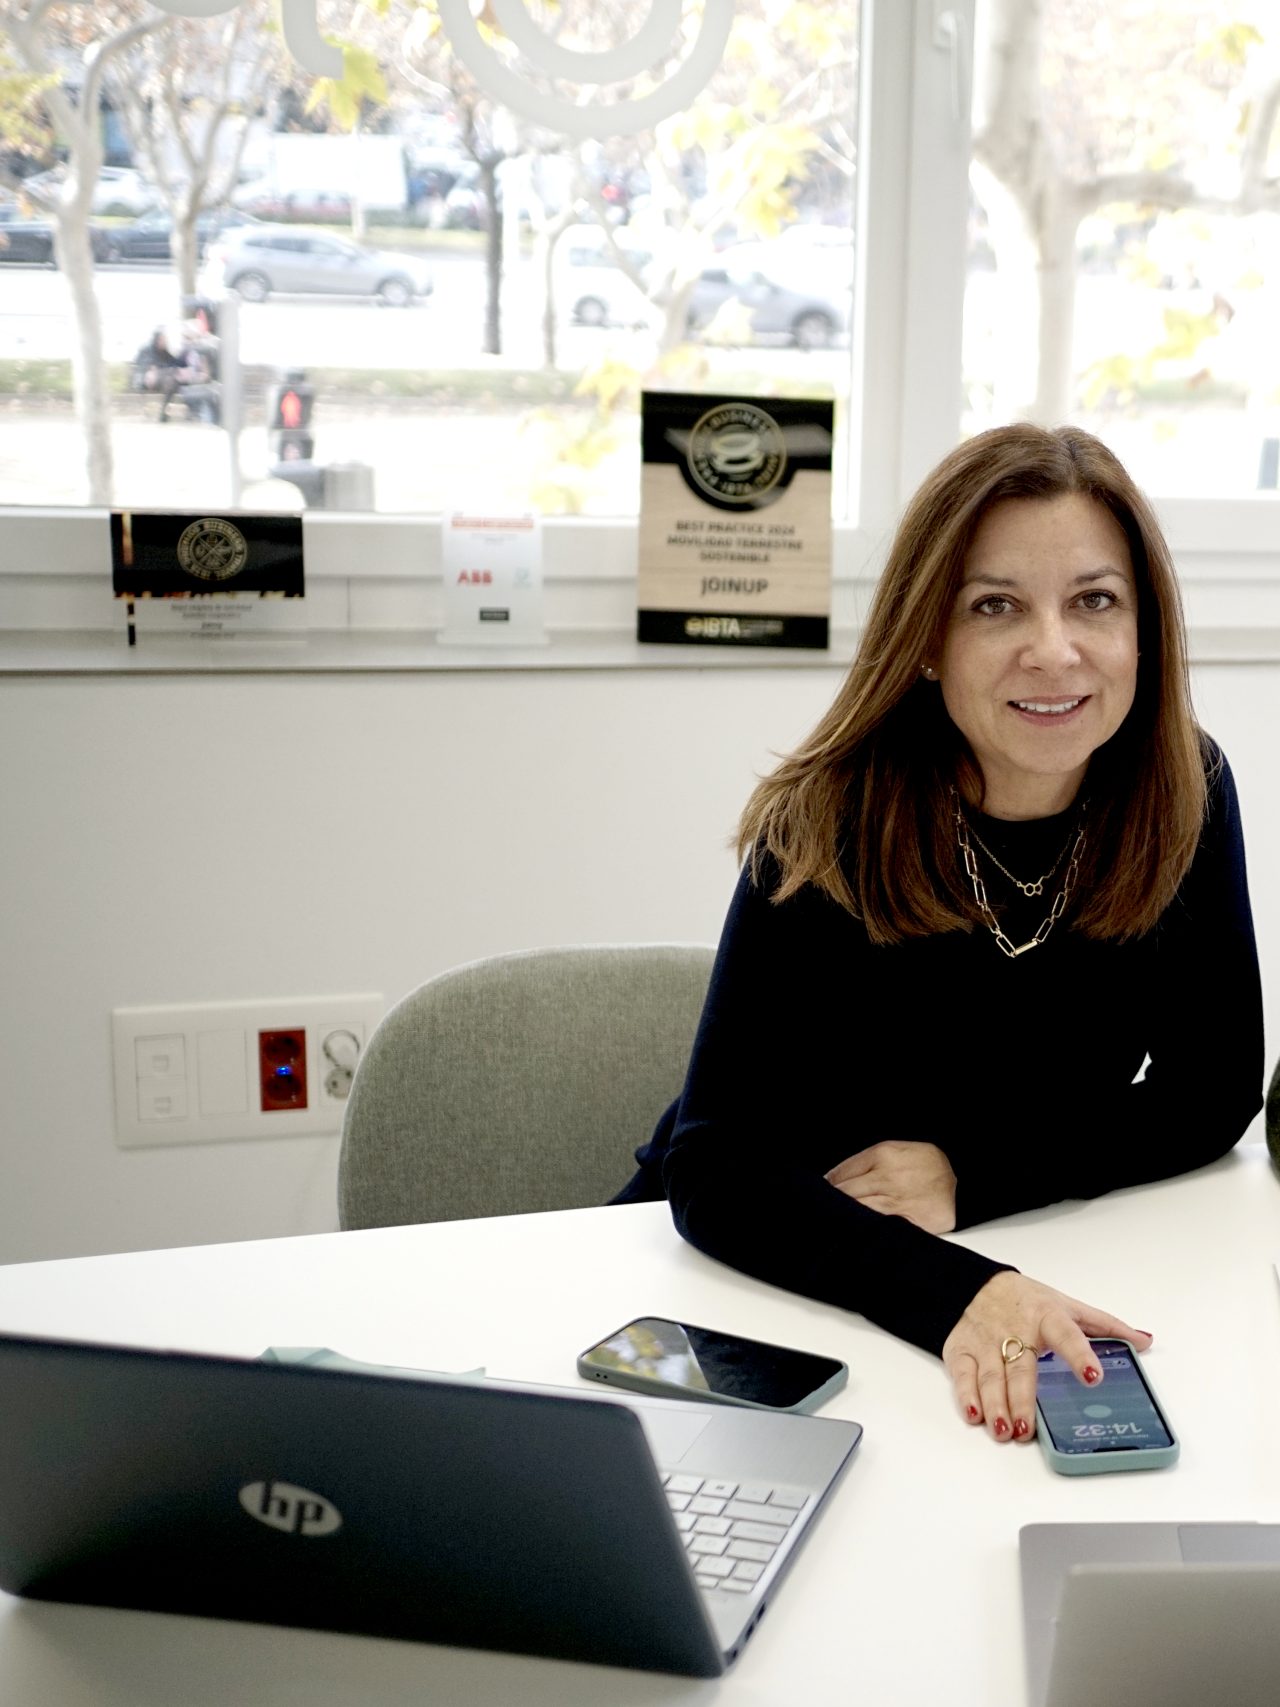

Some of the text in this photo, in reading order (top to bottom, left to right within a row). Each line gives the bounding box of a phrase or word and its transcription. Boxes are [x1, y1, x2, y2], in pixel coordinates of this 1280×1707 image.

[676, 519, 705, 532] BEST
[708, 521, 764, 534] PRACTICE
[667, 535, 804, 550] MOVILIDAD TERRESTRE
[700, 550, 771, 562] SOSTENIBLE
[457, 569, 493, 585] ABB
[701, 576, 768, 595] JOINUP
[1073, 1422, 1142, 1437] 14:32
[260, 1481, 325, 1535] hp
